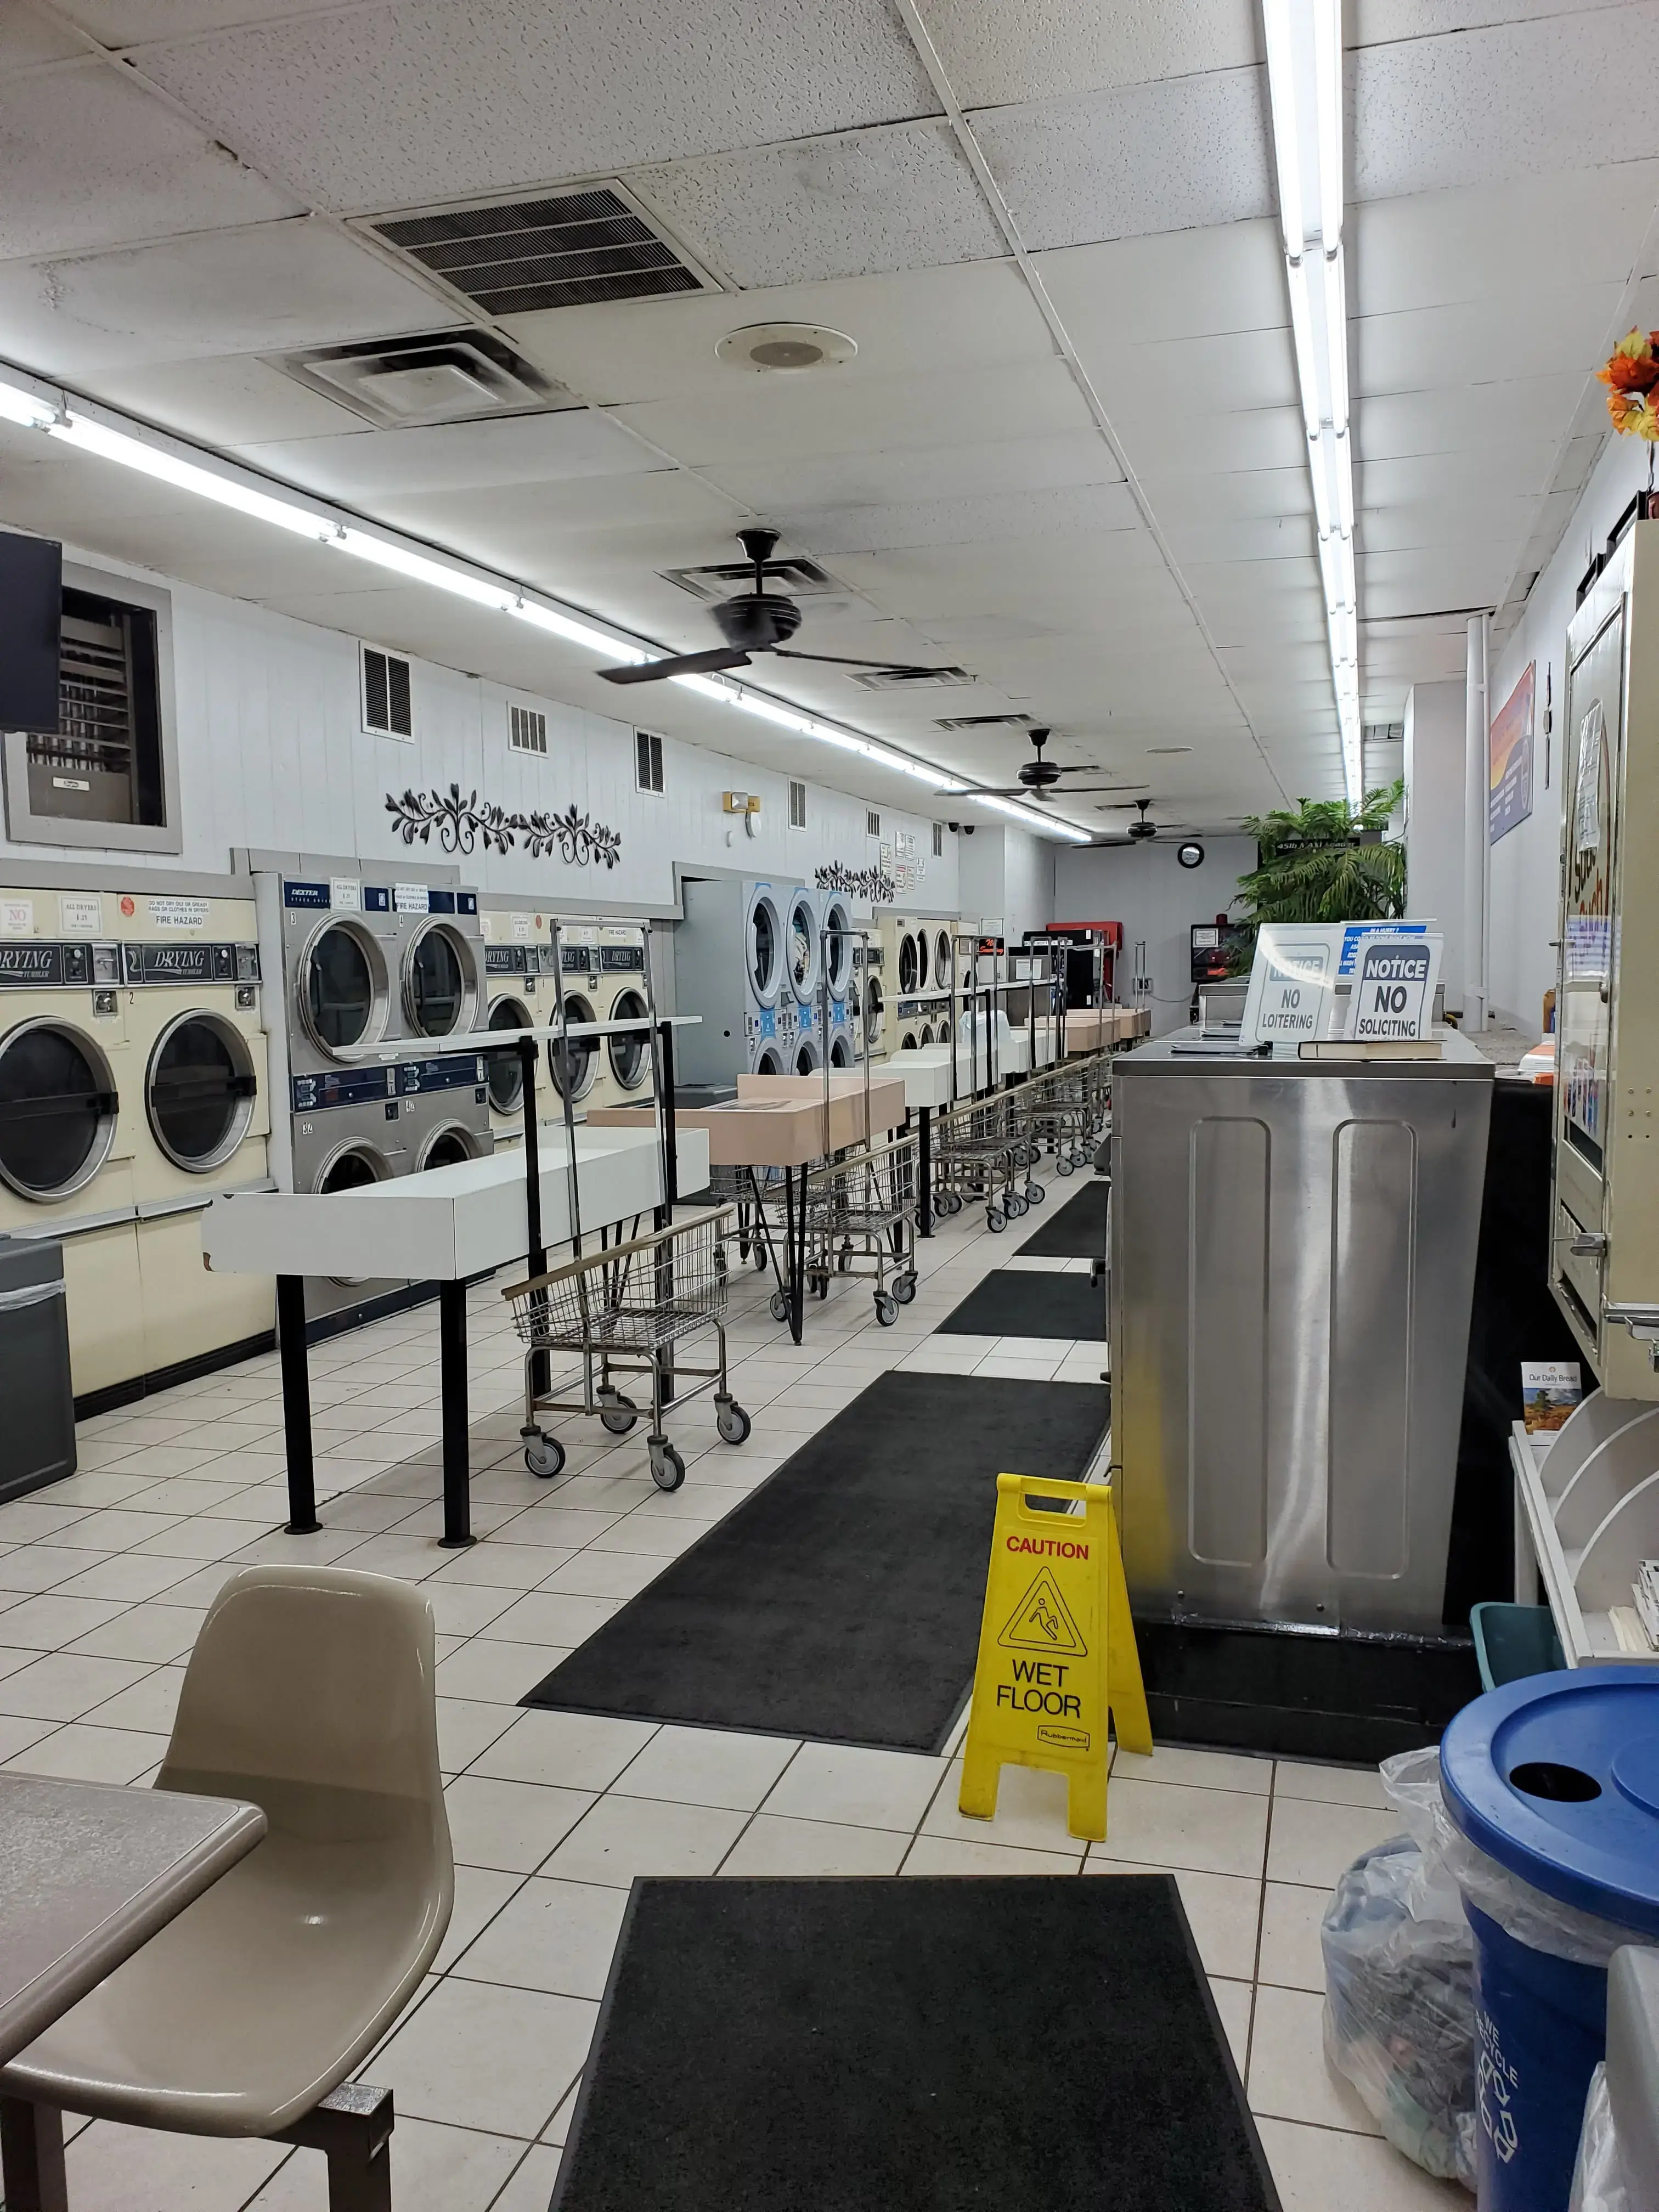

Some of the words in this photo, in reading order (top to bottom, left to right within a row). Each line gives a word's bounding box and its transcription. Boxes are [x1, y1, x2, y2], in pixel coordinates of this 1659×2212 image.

[9, 909, 26, 921] NO
[156, 916, 171, 924] FIRE
[174, 916, 202, 925] HAZARD
[291, 912, 295, 924] 3
[154, 951, 205, 968] DRYING
[612, 951, 631, 961] DRYING
[1365, 960, 1426, 979] NOTICE
[129, 991, 134, 1004] 2
[1281, 989, 1300, 1008] NO
[1374, 986, 1407, 1013] NO
[1262, 1013, 1313, 1029] LOITERING
[1359, 1019, 1415, 1036] SOLICITING
[1542, 1374, 1558, 1383] Daily
[1006, 1536, 1089, 1560] CAUTION
[1012, 1659, 1069, 1688] WET
[996, 1685, 1081, 1719] FLOOR
[1041, 1729, 1087, 1743] Rubbermaid
[1483, 2011, 1499, 2048] WE
[1476, 2009, 1519, 2090] RECYCLE
